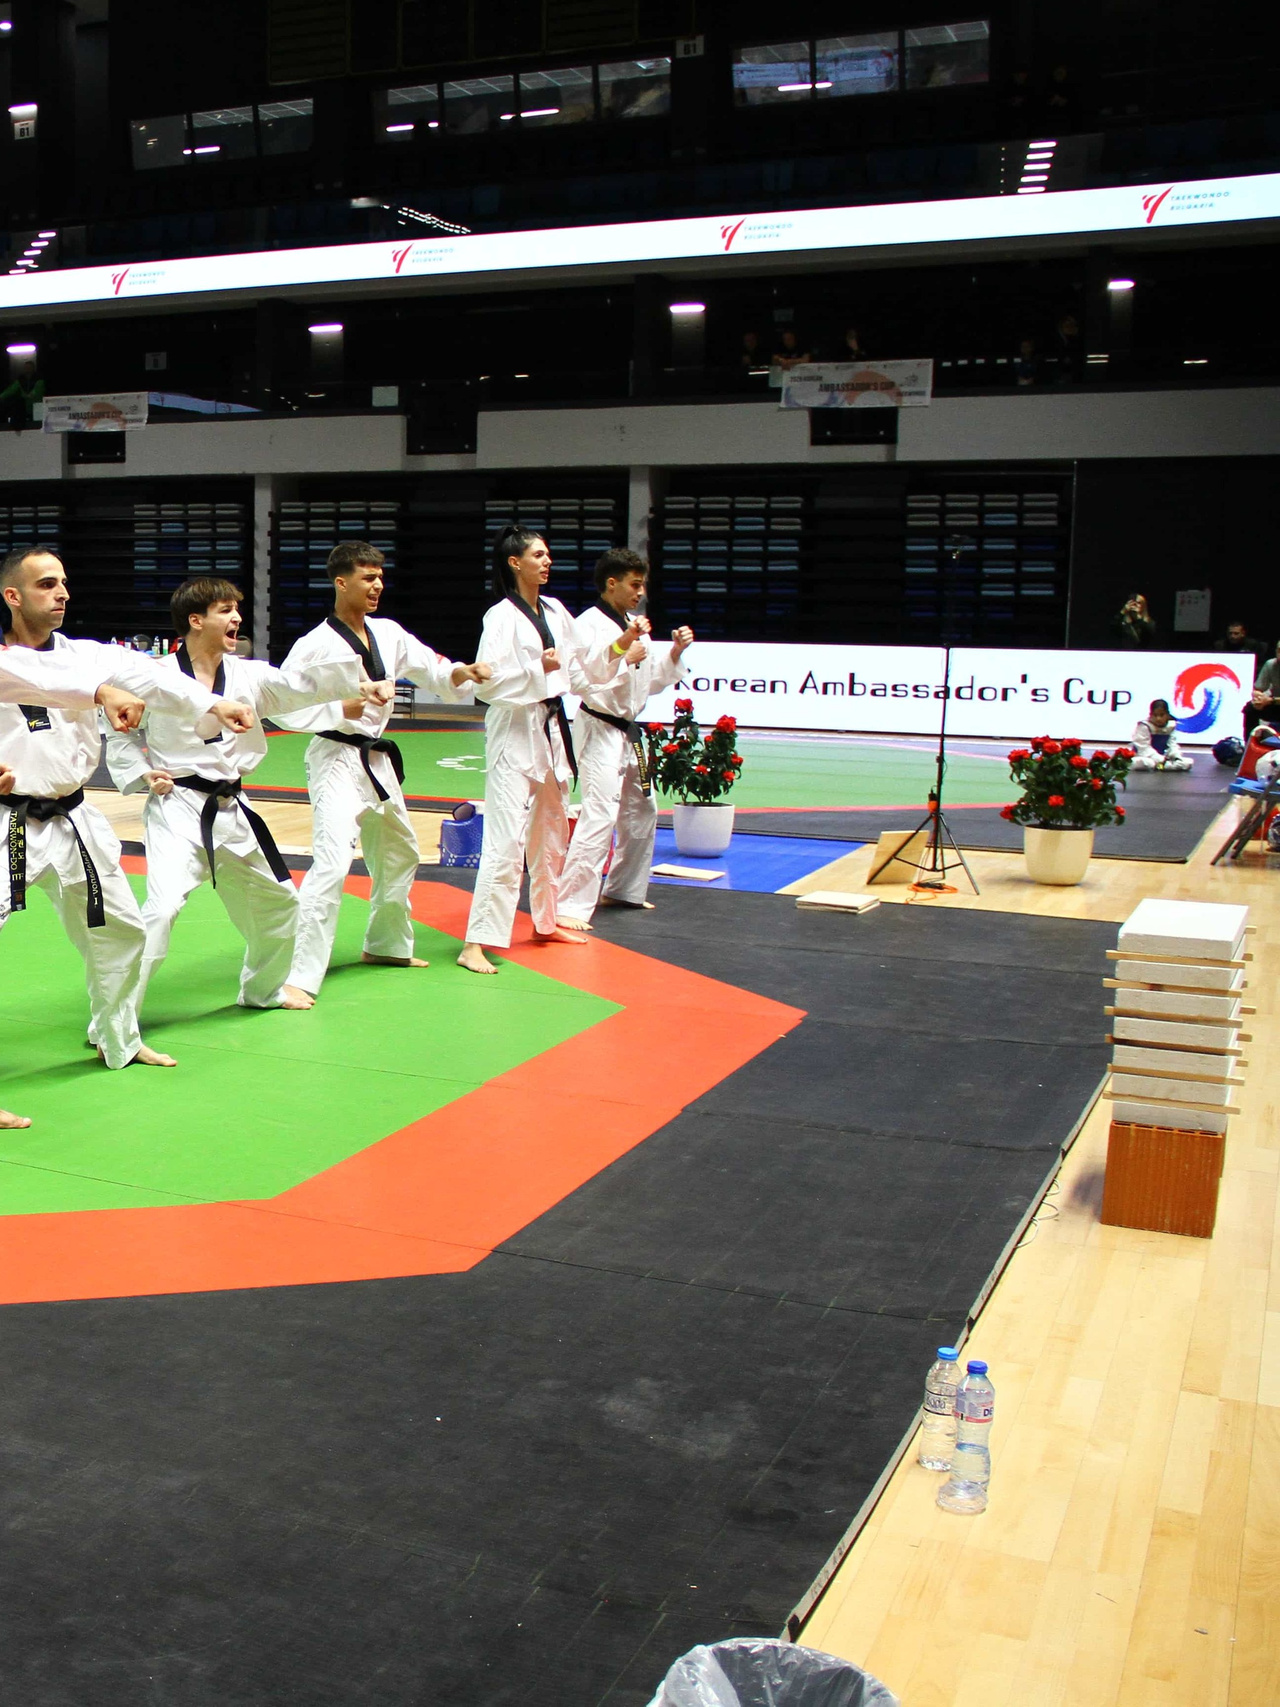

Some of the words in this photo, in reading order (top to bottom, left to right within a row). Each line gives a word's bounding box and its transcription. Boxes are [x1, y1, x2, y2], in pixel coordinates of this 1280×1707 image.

[1171, 191, 1230, 200] TAEKWONDO
[799, 670, 1050, 702] Ambassador's
[1063, 677, 1133, 713] Cup
[9, 811, 19, 871] TAEKWON-DO
